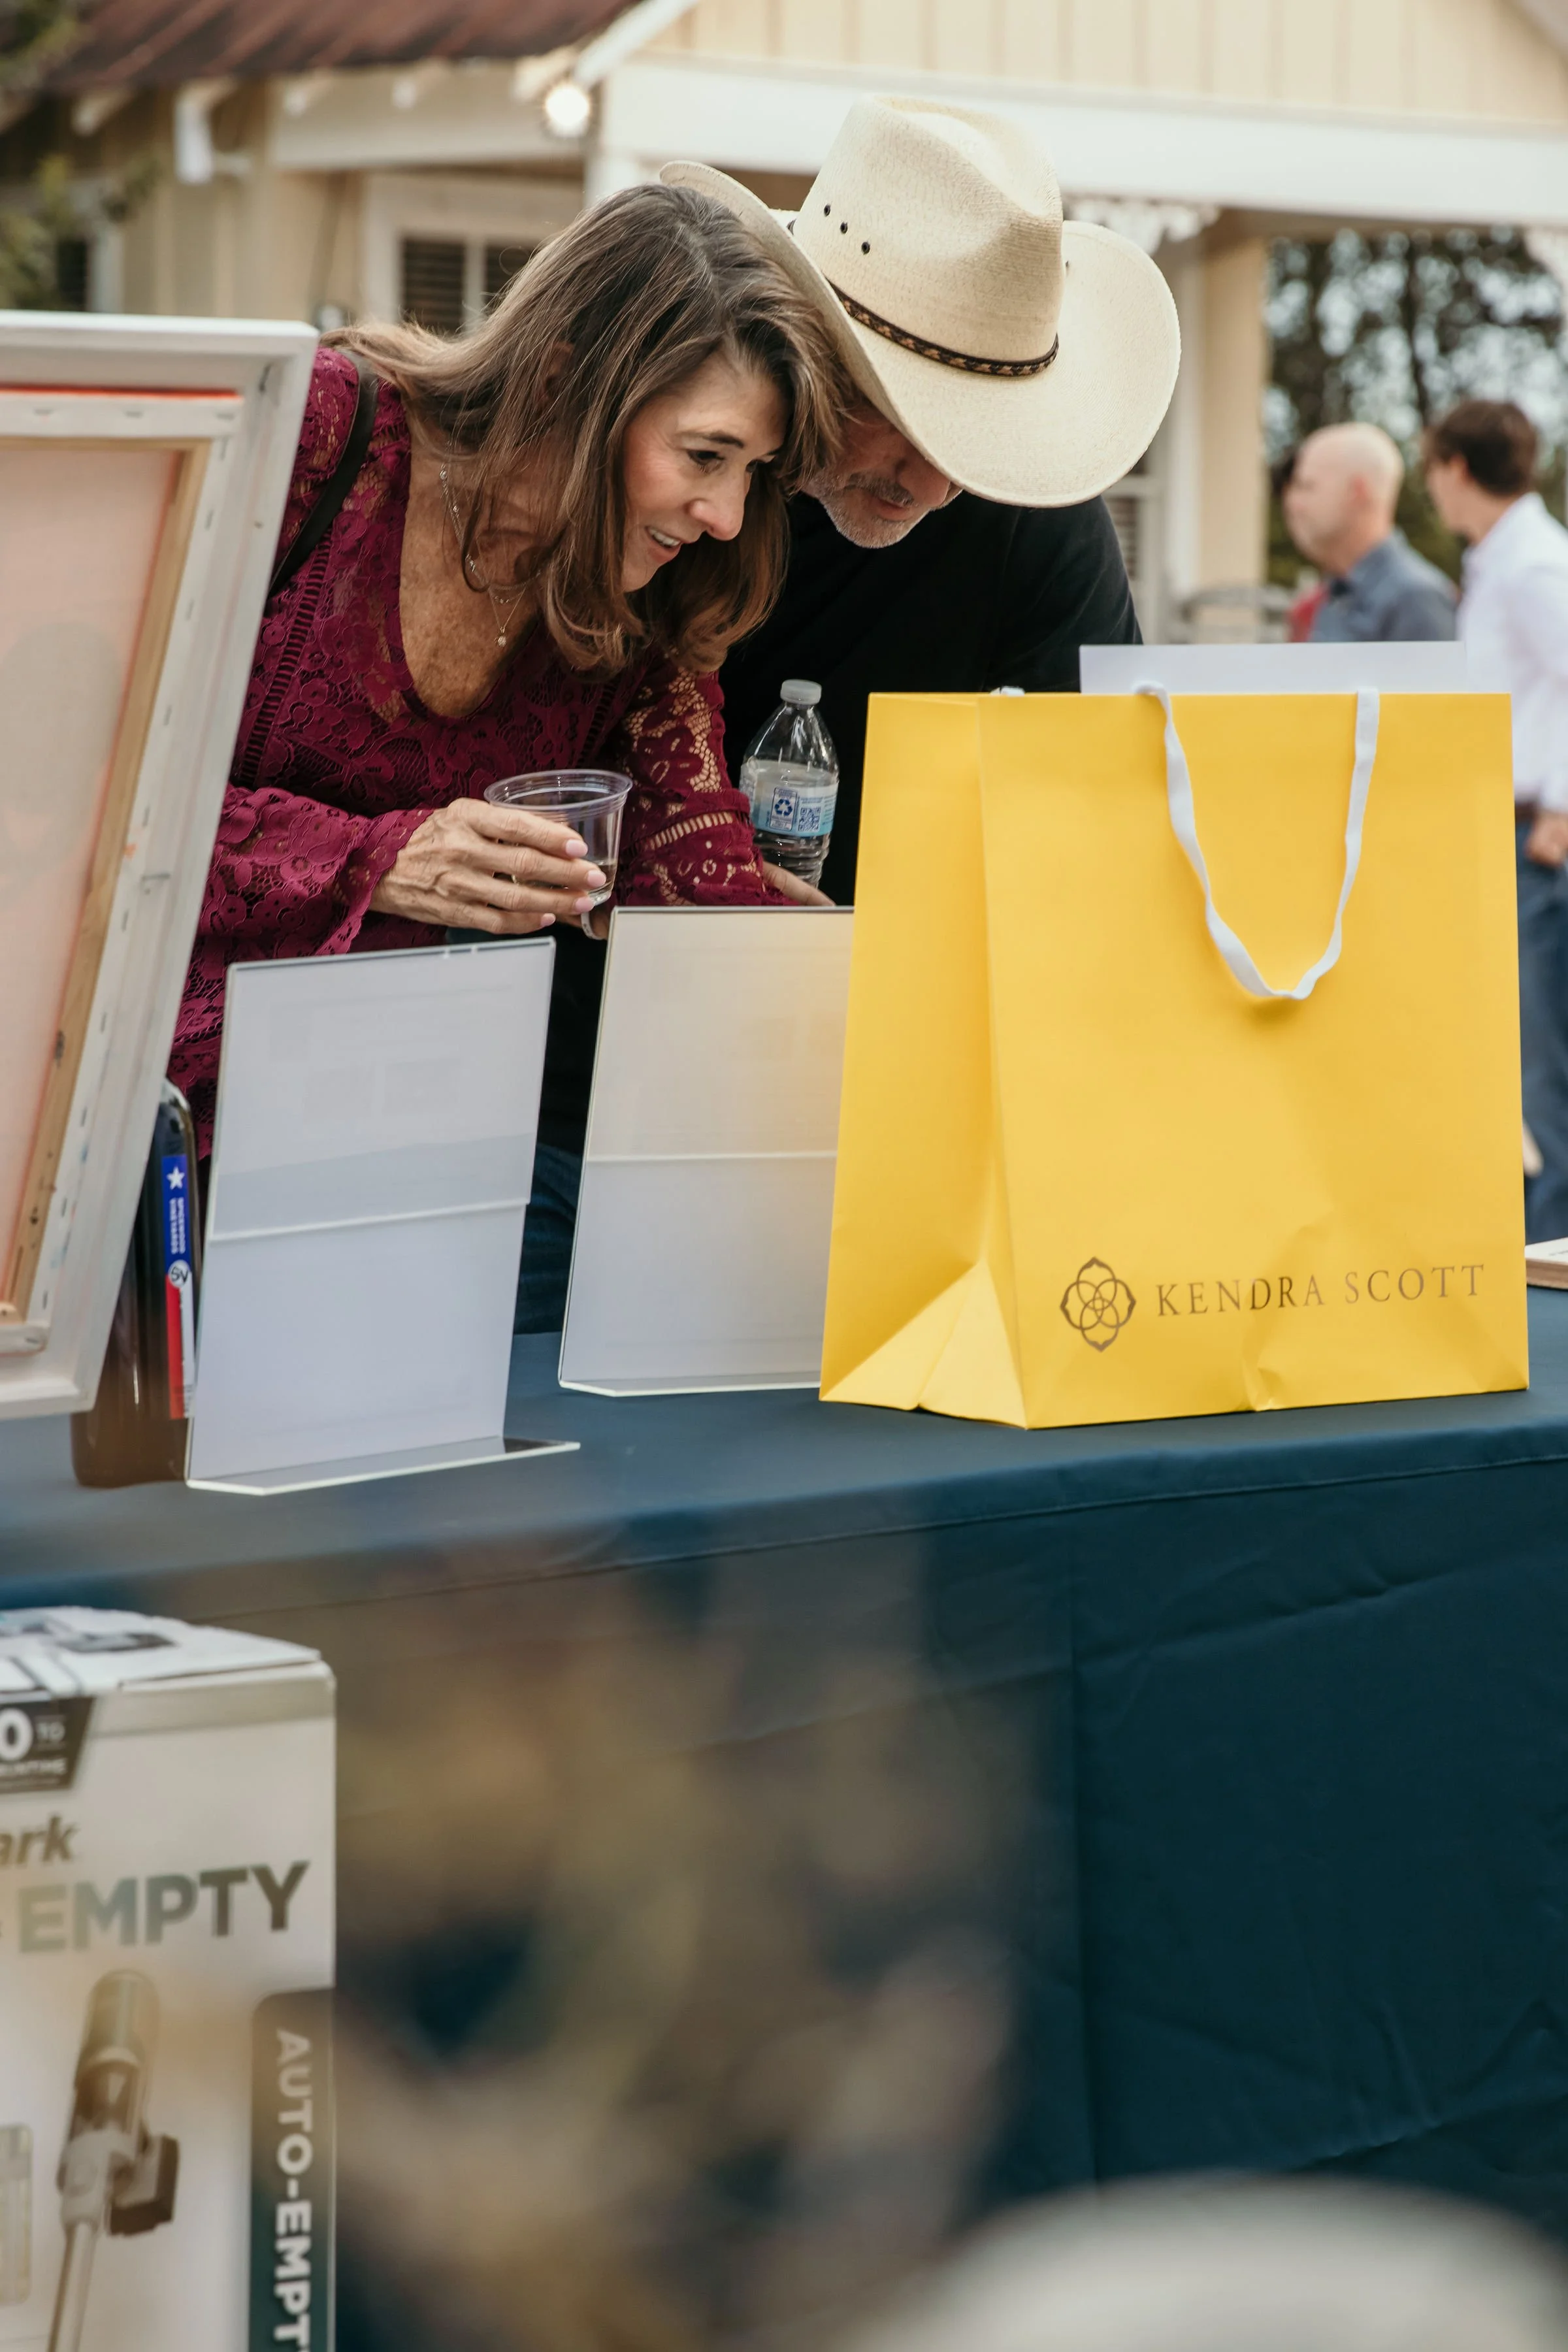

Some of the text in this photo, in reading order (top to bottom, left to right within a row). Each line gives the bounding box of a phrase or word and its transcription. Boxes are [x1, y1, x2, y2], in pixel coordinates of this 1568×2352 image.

[171, 1265, 189, 1284] SV
[1156, 1264, 1486, 1316] KENDRA SCOTT
[275, 2030, 312, 2352] AUTO-EMPT
